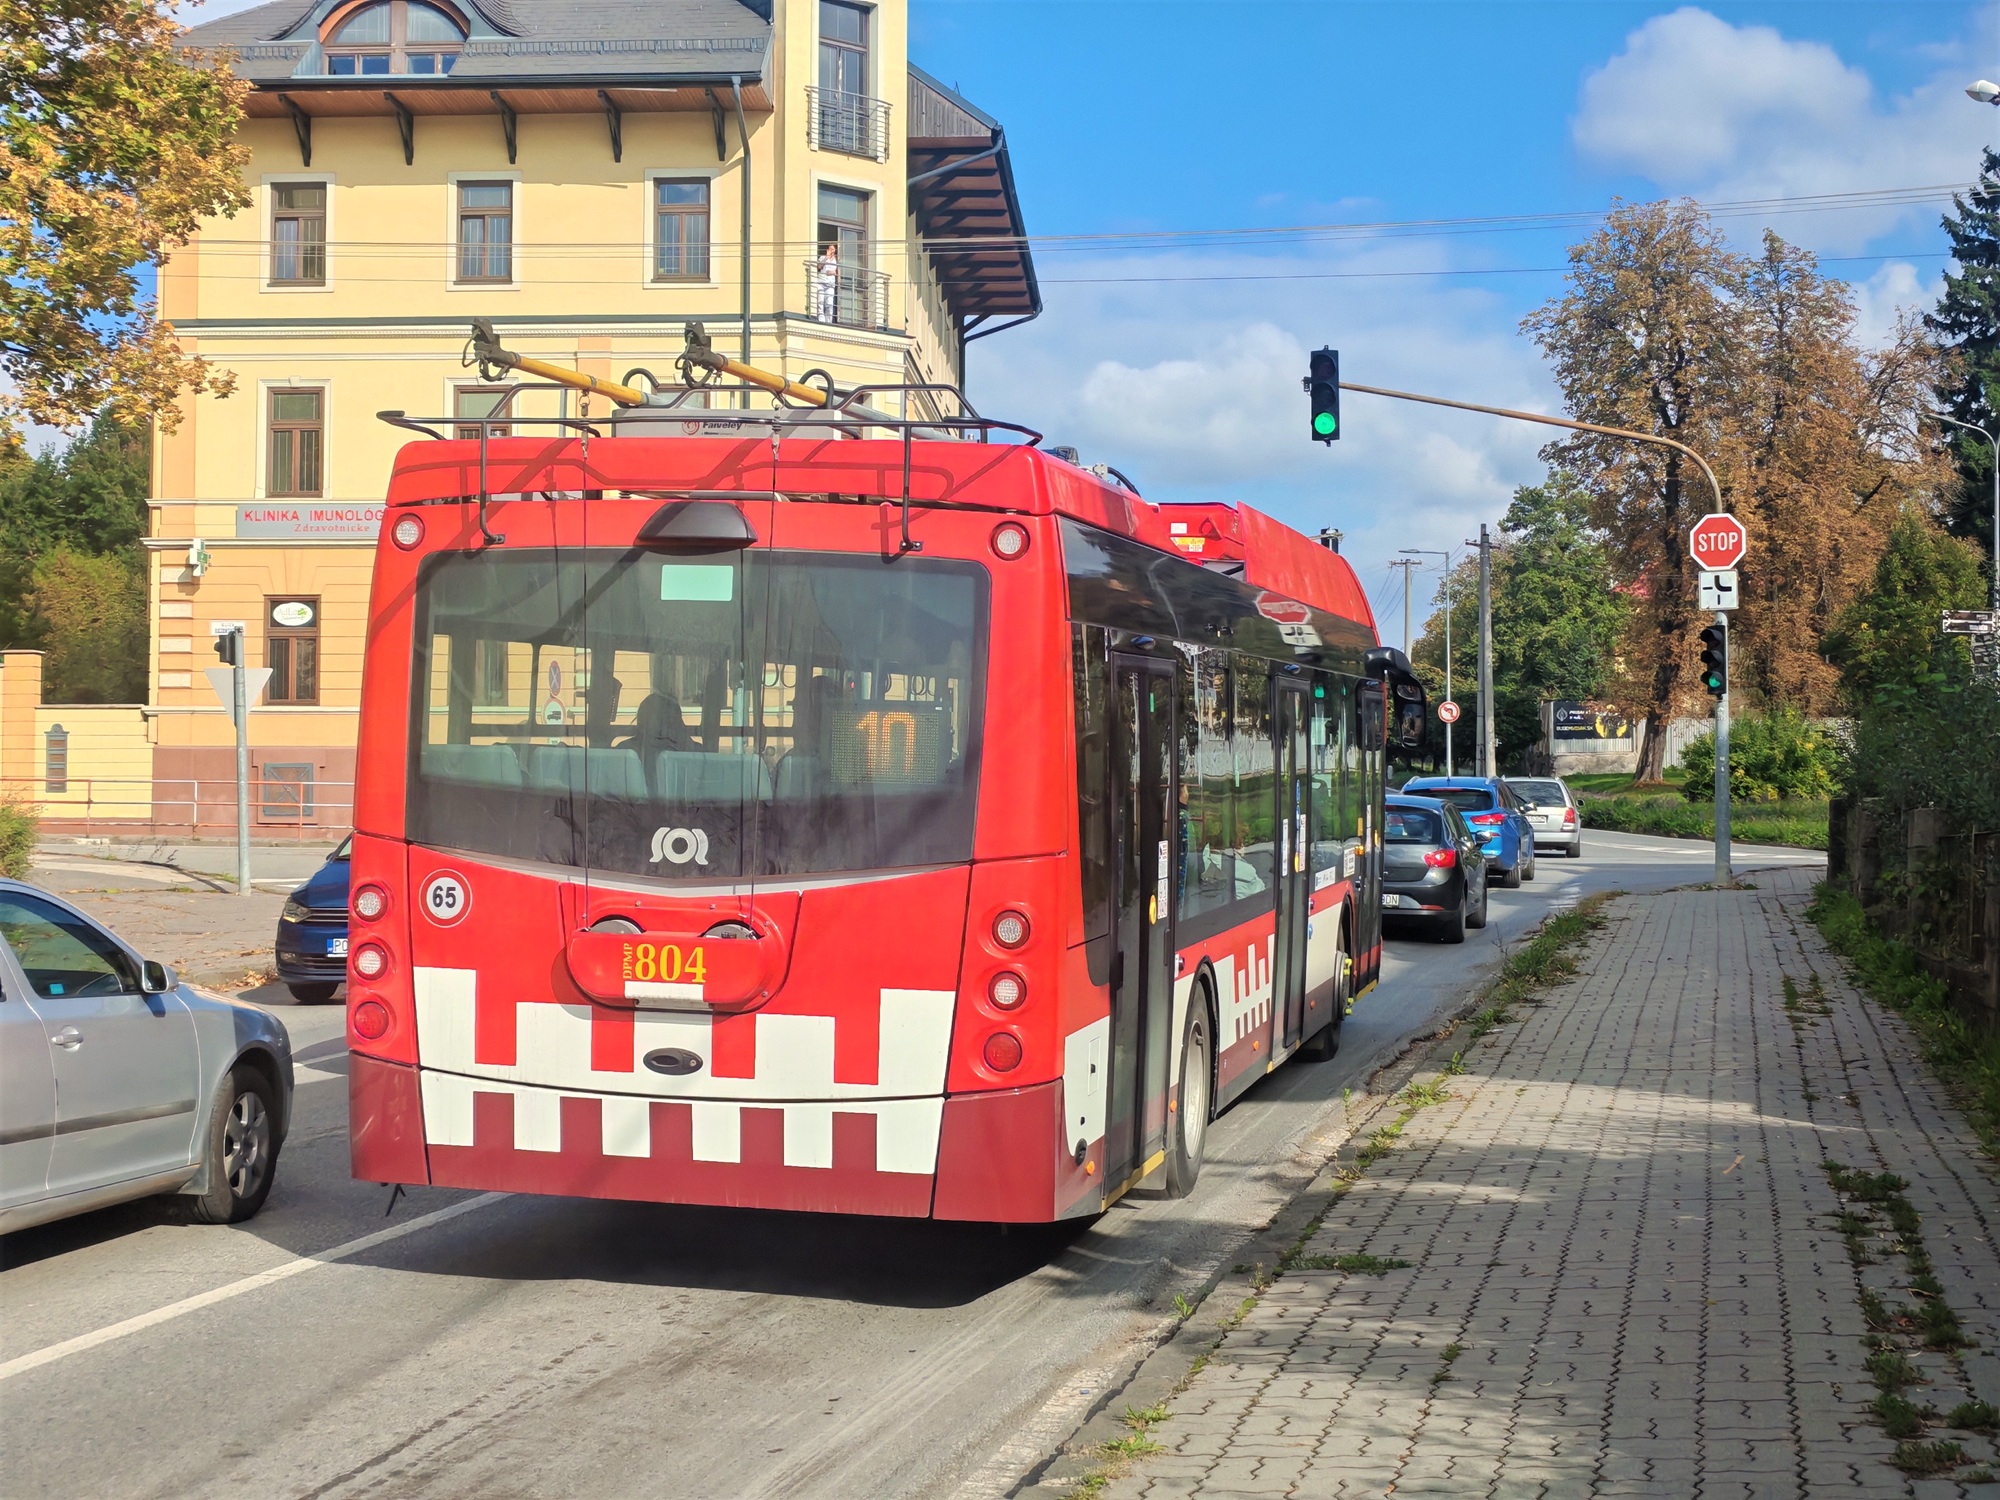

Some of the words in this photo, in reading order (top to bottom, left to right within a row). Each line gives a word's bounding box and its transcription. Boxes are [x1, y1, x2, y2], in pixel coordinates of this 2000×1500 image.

[244, 509, 300, 522] KLINIKA
[1698, 531, 1739, 553] STOP
[856, 711, 915, 775] 10
[432, 885, 457, 909] 65
[622, 943, 633, 979] DPMP
[634, 942, 707, 983] 804
